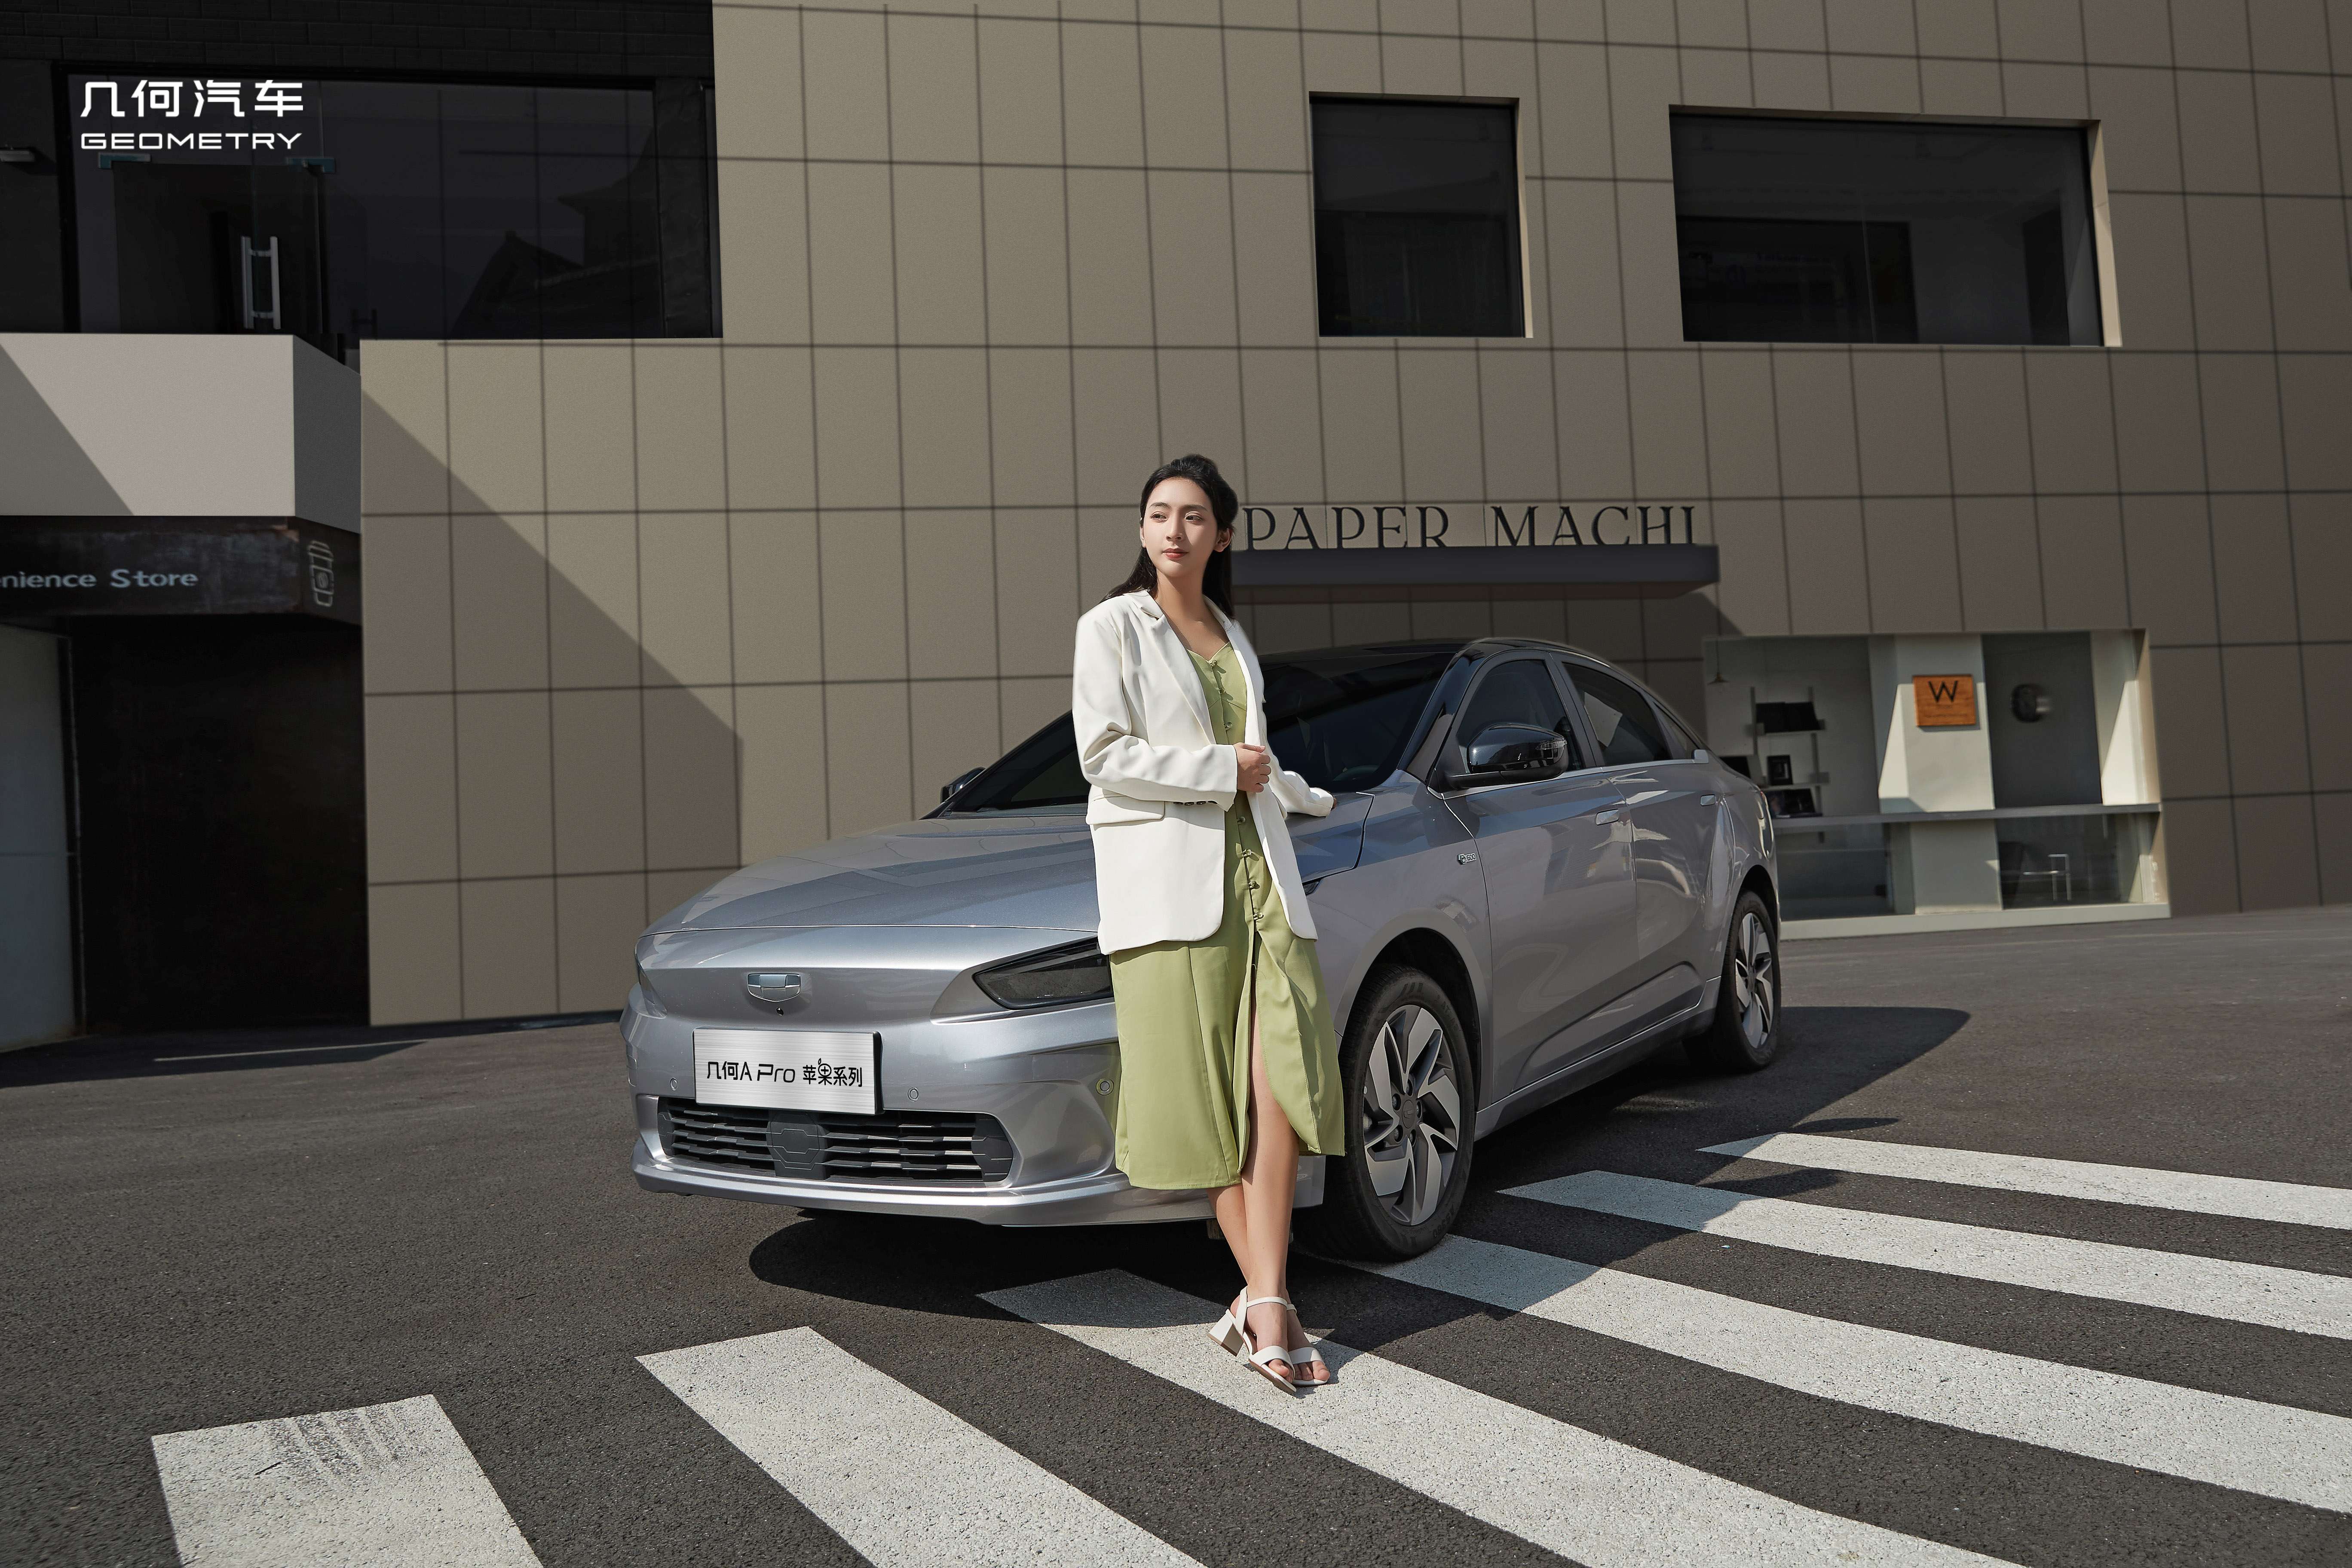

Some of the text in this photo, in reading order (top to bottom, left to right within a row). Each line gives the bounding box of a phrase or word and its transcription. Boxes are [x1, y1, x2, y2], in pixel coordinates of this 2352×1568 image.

[1242, 505, 1695, 550] PAPER MACHI
[0, 569, 199, 588] nience Store
[1928, 680, 1958, 703] W
[757, 1063, 796, 1083] Pro
[802, 1058, 862, 1087] 苹果系列
